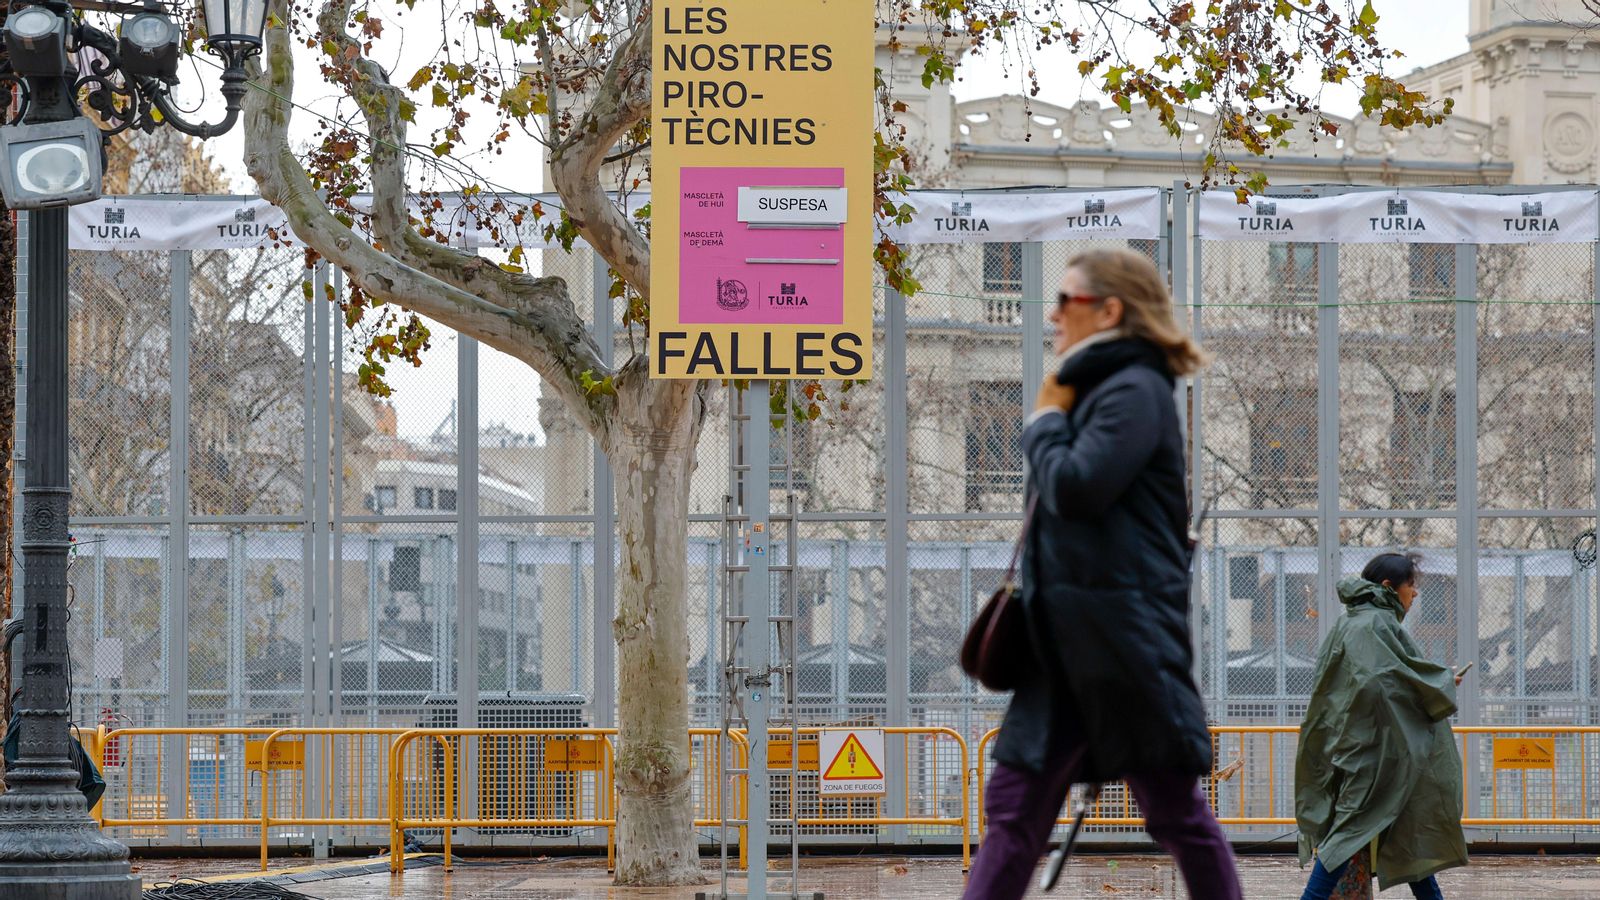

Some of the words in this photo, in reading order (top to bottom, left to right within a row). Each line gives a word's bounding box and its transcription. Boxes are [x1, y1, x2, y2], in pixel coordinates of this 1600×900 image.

[664, 7, 728, 34] LES
[663, 44, 833, 71] NOSTRES
[663, 81, 764, 108] PIRO-
[661, 110, 816, 145] TÈCNIES
[683, 192, 724, 200] MASCLETÀ
[758, 197, 828, 211] SUSPESA
[933, 218, 990, 231] TURIA
[1066, 214, 1123, 228] TURIA
[1238, 217, 1294, 231] TURIA
[1369, 217, 1426, 231] TURIA
[1503, 218, 1560, 232] TURIA
[87, 225, 141, 239] TURIA
[767, 296, 809, 306] TURIA
[658, 332, 863, 375] FALLES
[854, 783, 883, 791] FUEGOS
